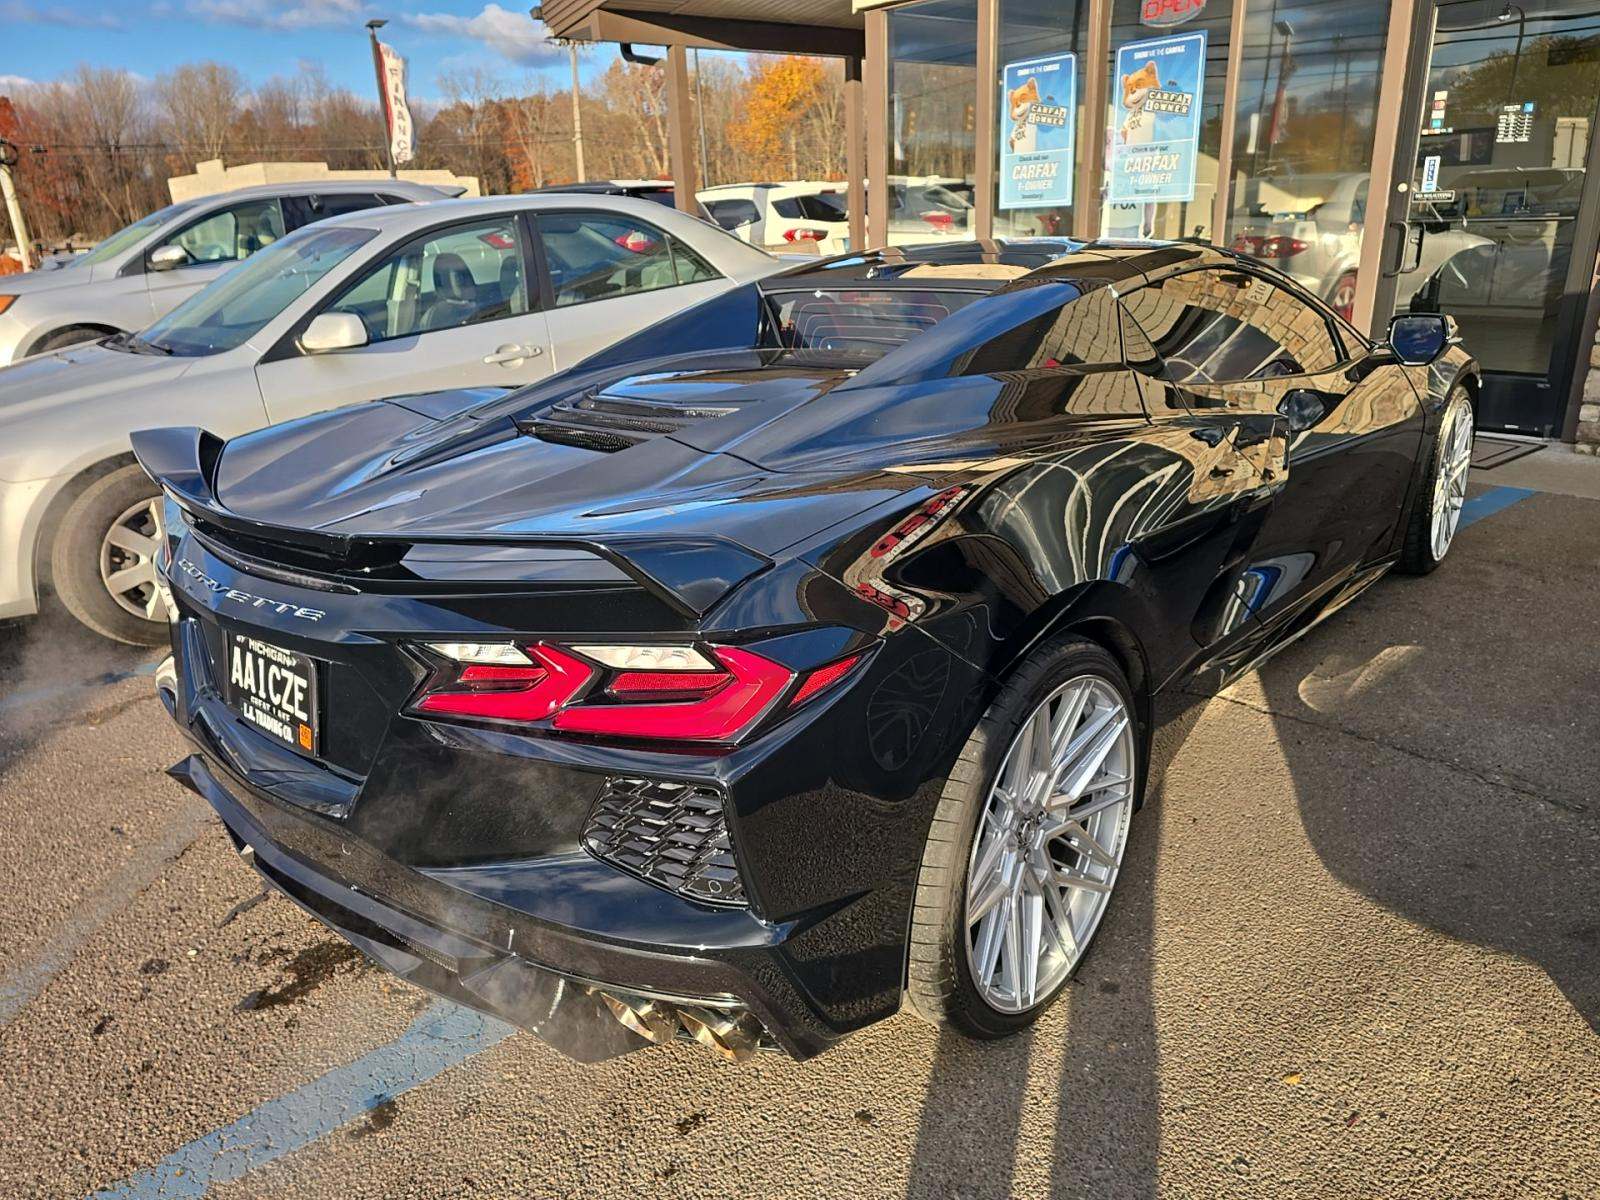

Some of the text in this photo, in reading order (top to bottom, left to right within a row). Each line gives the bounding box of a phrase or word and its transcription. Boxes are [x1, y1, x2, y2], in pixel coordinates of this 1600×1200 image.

[1148, 91, 1193, 105] CARFAX
[1012, 161, 1060, 180] CARFAX
[1124, 153, 1181, 173] CARFAX
[178, 558, 327, 622] CORVETTE
[249, 638, 292, 668] MICHIGAN
